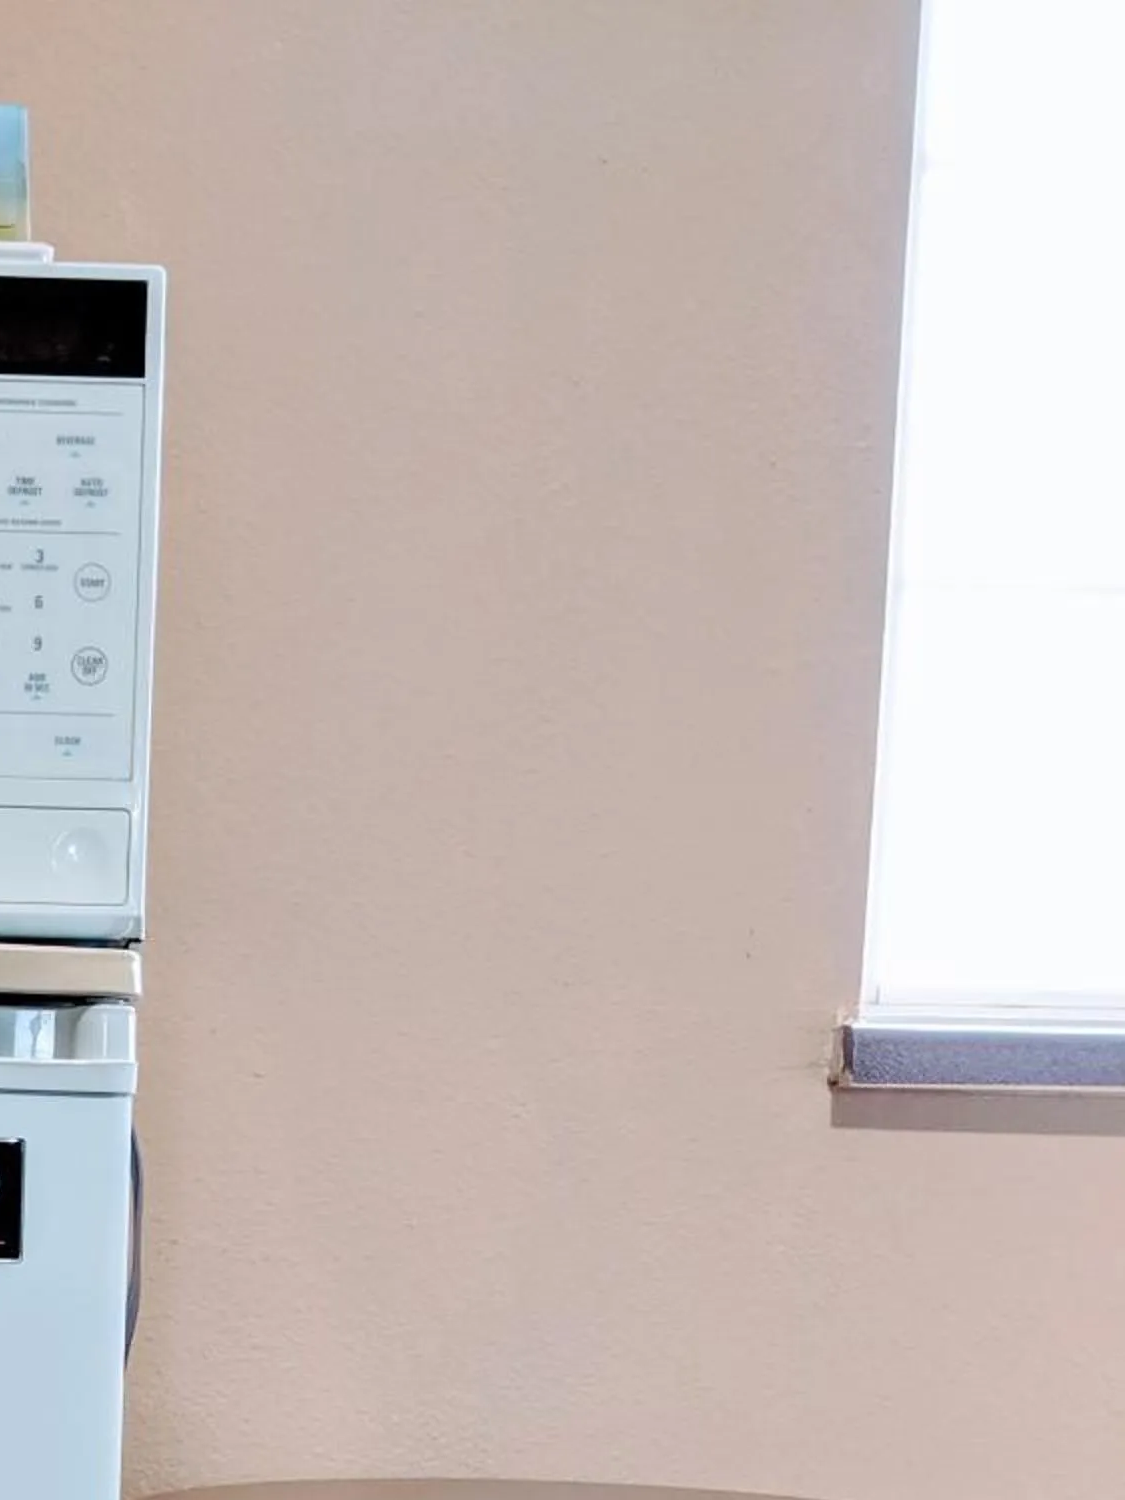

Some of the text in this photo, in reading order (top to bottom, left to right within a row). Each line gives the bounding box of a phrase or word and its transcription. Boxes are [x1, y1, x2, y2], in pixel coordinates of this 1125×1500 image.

[35, 549, 44, 564] 3
[34, 595, 43, 609] 6
[34, 636, 42, 651] 9
